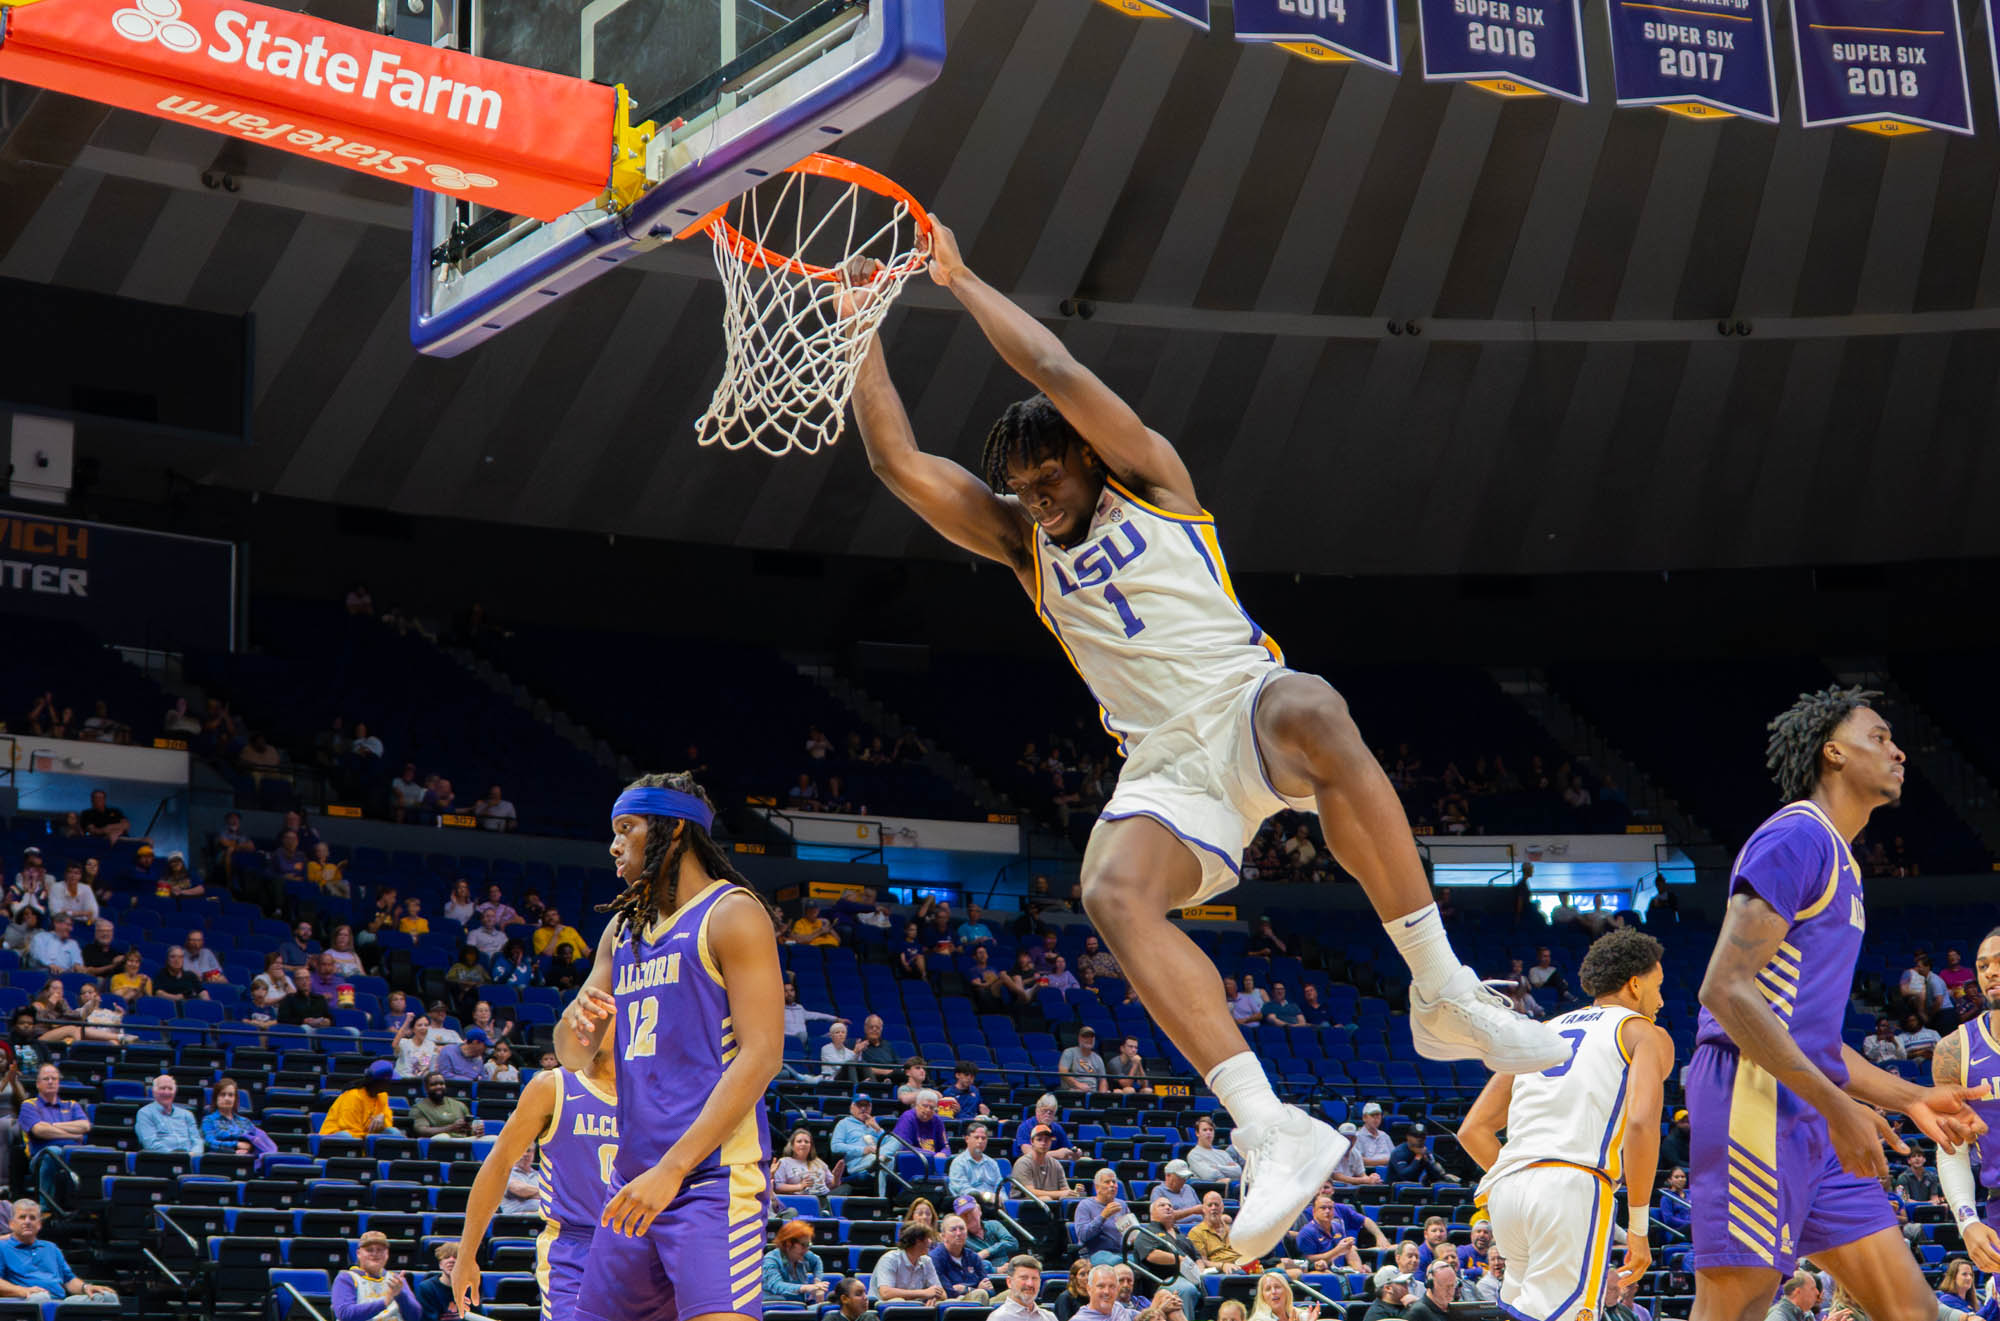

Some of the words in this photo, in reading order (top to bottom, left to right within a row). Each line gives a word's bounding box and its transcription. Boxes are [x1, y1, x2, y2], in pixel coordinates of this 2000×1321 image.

[1455, 0, 1510, 21] SUPER
[1516, 6, 1545, 26] SIX
[1468, 21, 1536, 59] 2016
[1644, 22, 1701, 45] SUPER
[1706, 29, 1735, 50] SIX
[1659, 47, 1724, 81] 2017
[1832, 43, 1892, 63] SUPER
[1897, 46, 1927, 65] SIX
[1847, 67, 1919, 97] 2018
[1051, 519, 1147, 597] LSU
[0, 560, 89, 597] TER
[1103, 582, 1146, 639] 1
[614, 952, 681, 995] ALCORN
[624, 995, 659, 1061] 12
[1560, 1010, 1606, 1025] TAMBA
[1165, 1085, 1187, 1096] 104
